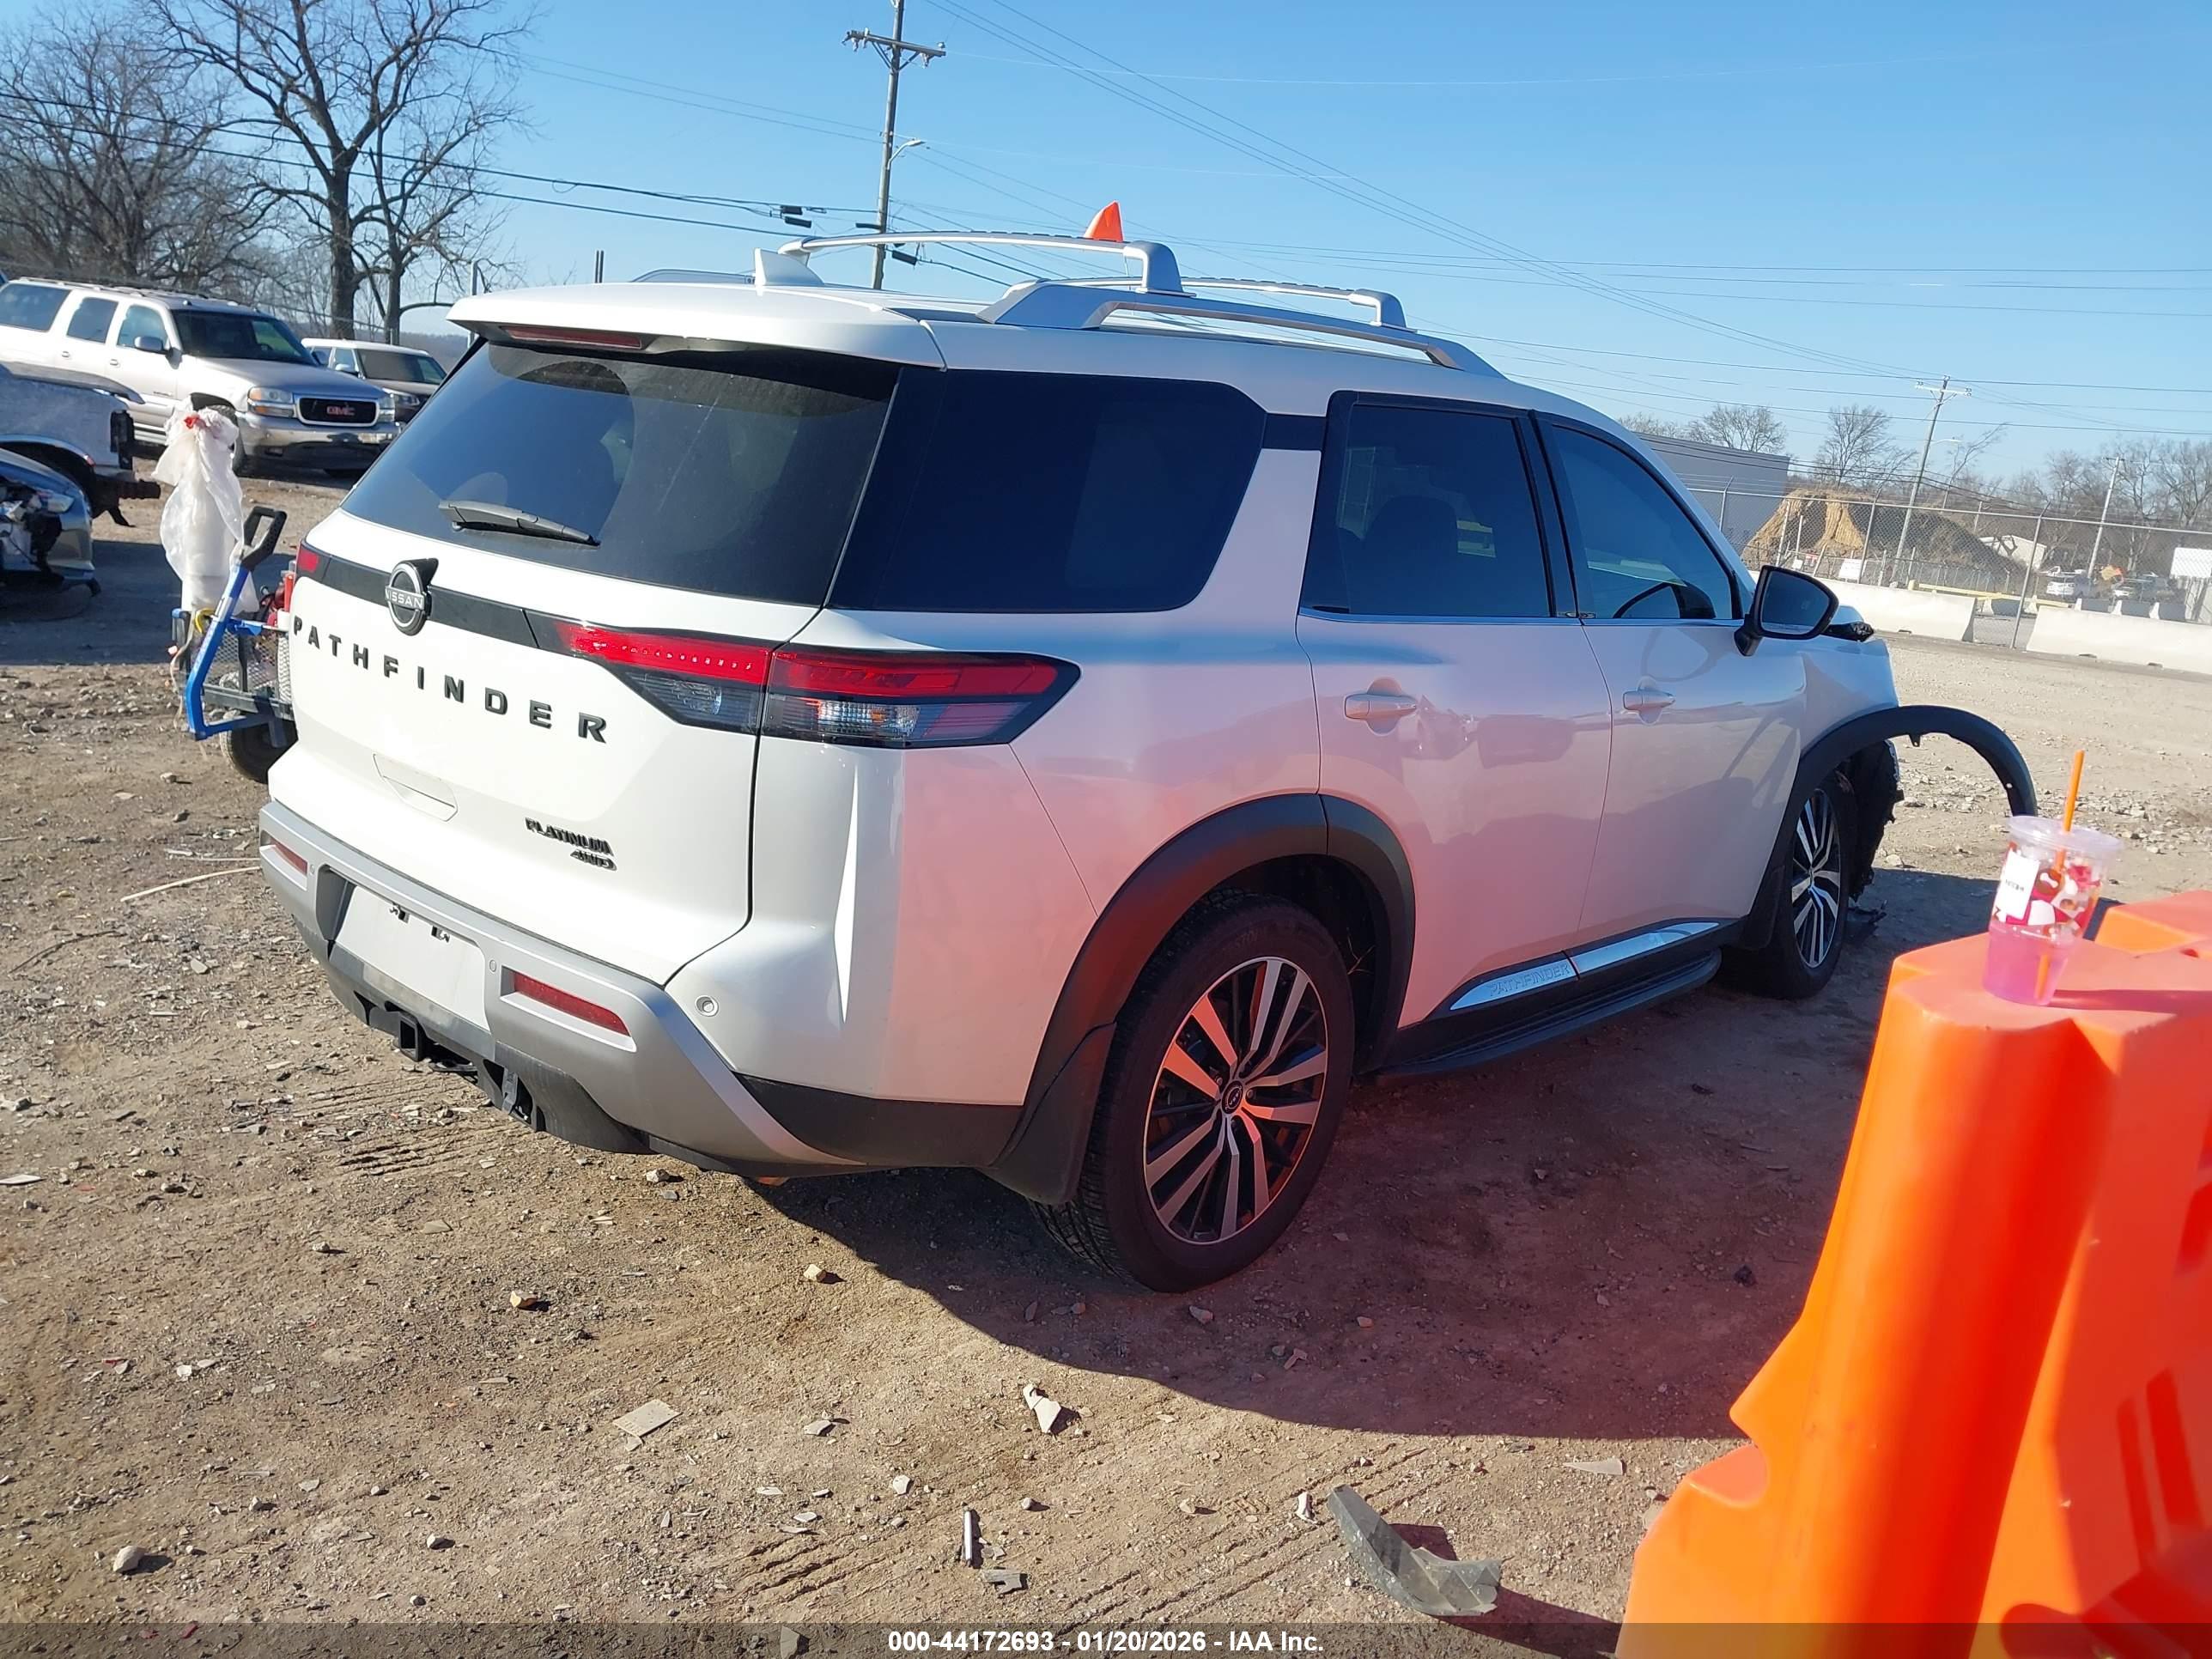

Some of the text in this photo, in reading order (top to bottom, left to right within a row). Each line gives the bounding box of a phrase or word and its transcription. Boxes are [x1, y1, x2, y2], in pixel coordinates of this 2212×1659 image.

[326, 405, 356, 416] GMC
[385, 587, 423, 610] NISSAN
[293, 615, 607, 744] PATHFINDER
[525, 817, 615, 857] PLATINUM
[569, 848, 617, 872] 4WD
[1488, 962, 1571, 997] PATHFINDER
